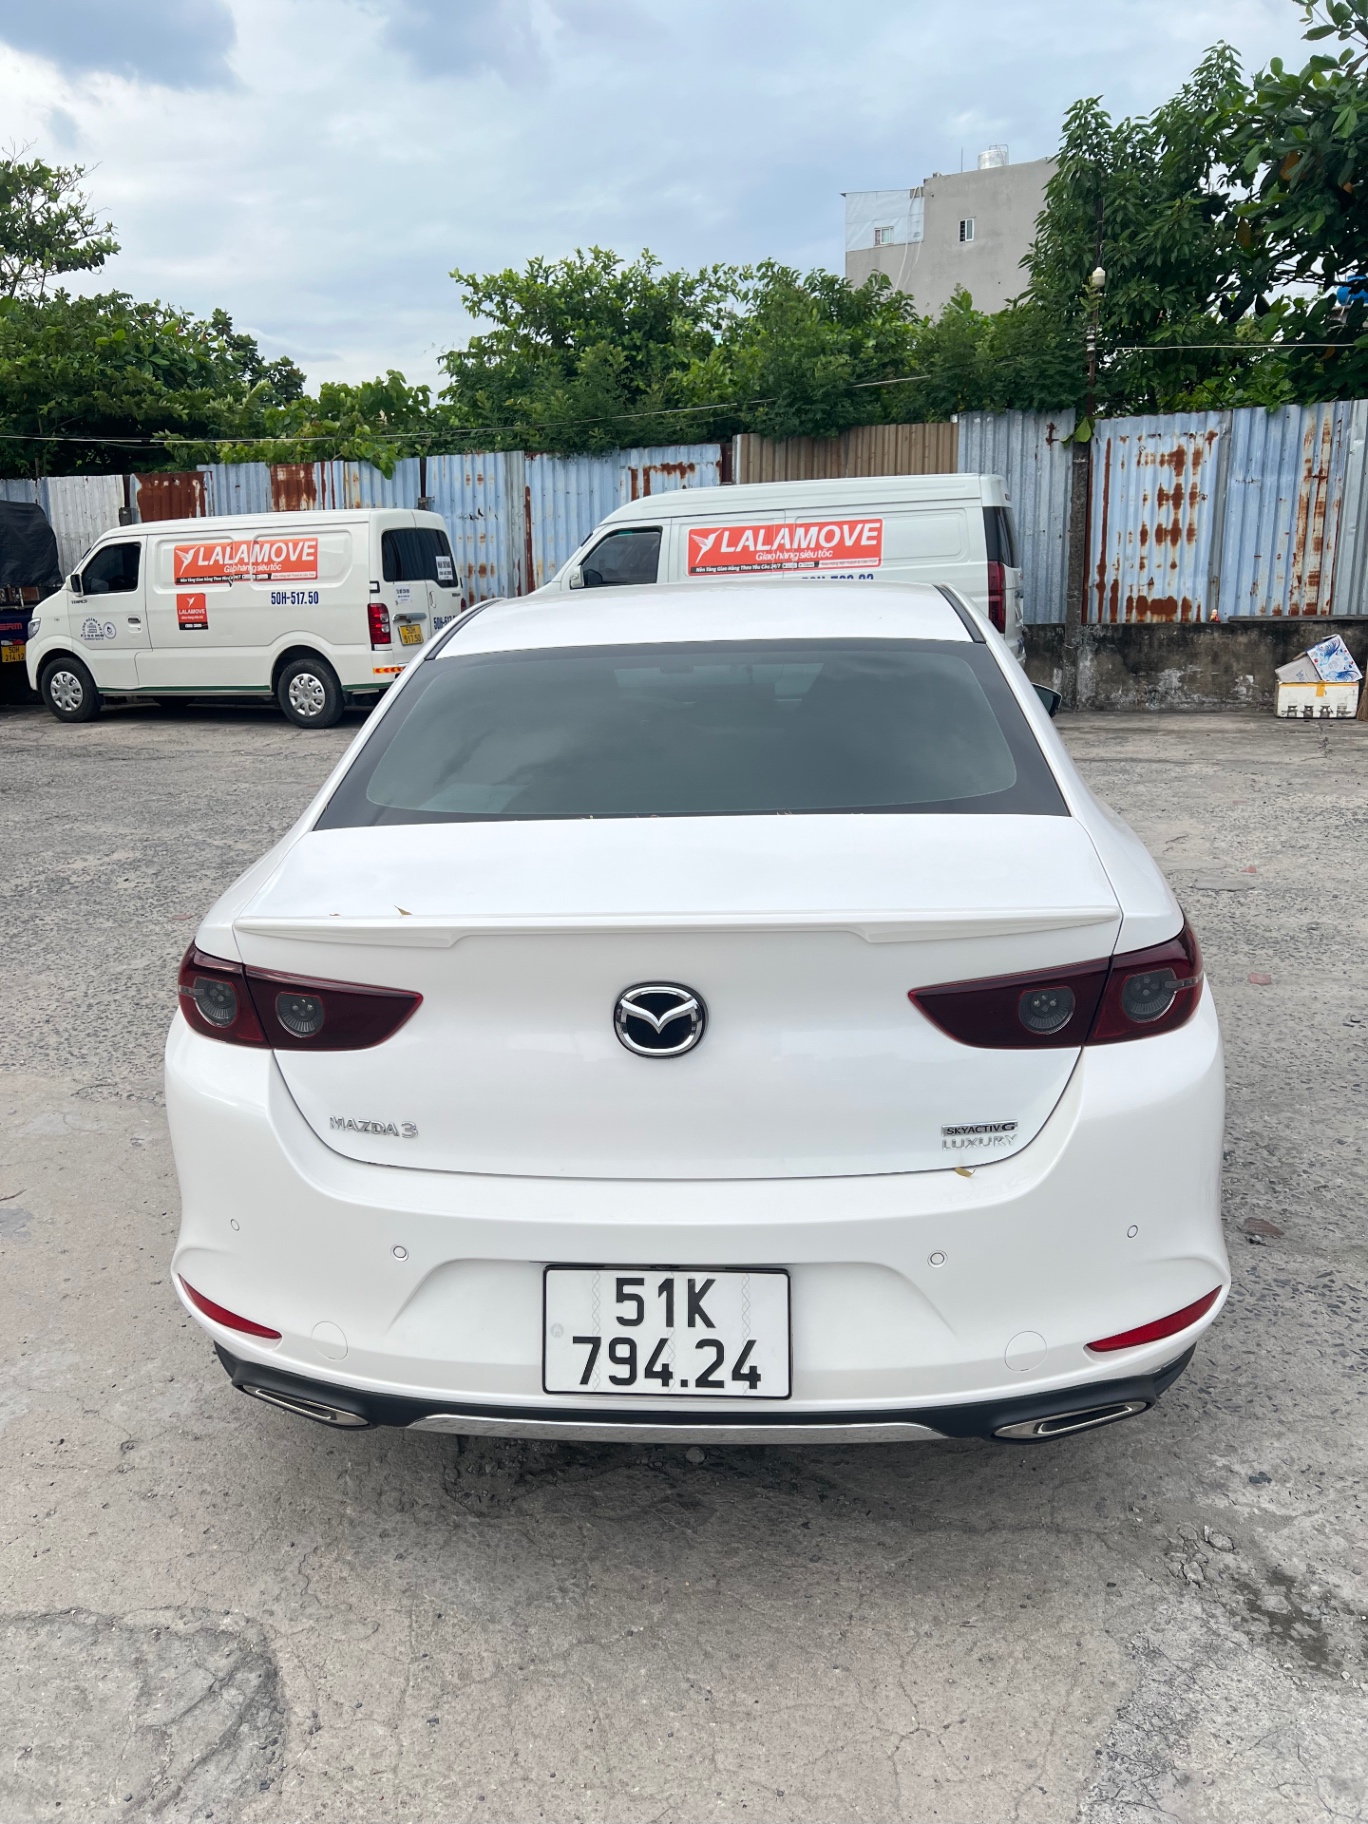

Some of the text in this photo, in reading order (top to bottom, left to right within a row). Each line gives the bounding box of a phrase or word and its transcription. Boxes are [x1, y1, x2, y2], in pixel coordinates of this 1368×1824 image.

[720, 522, 881, 553] LALAMOVE
[197, 541, 317, 566] LALAMOVE
[755, 547, 834, 562] Giao hàng siêu tốc
[271, 591, 319, 605] 50H-517.50
[403, 633, 422, 644] 51750
[5, 652, 25, 662] 21412
[328, 1115, 419, 1139] MAZDA 3
[941, 1133, 1018, 1151] LUXURY
[615, 1277, 717, 1329] 51K
[572, 1336, 762, 1390] 794.24
